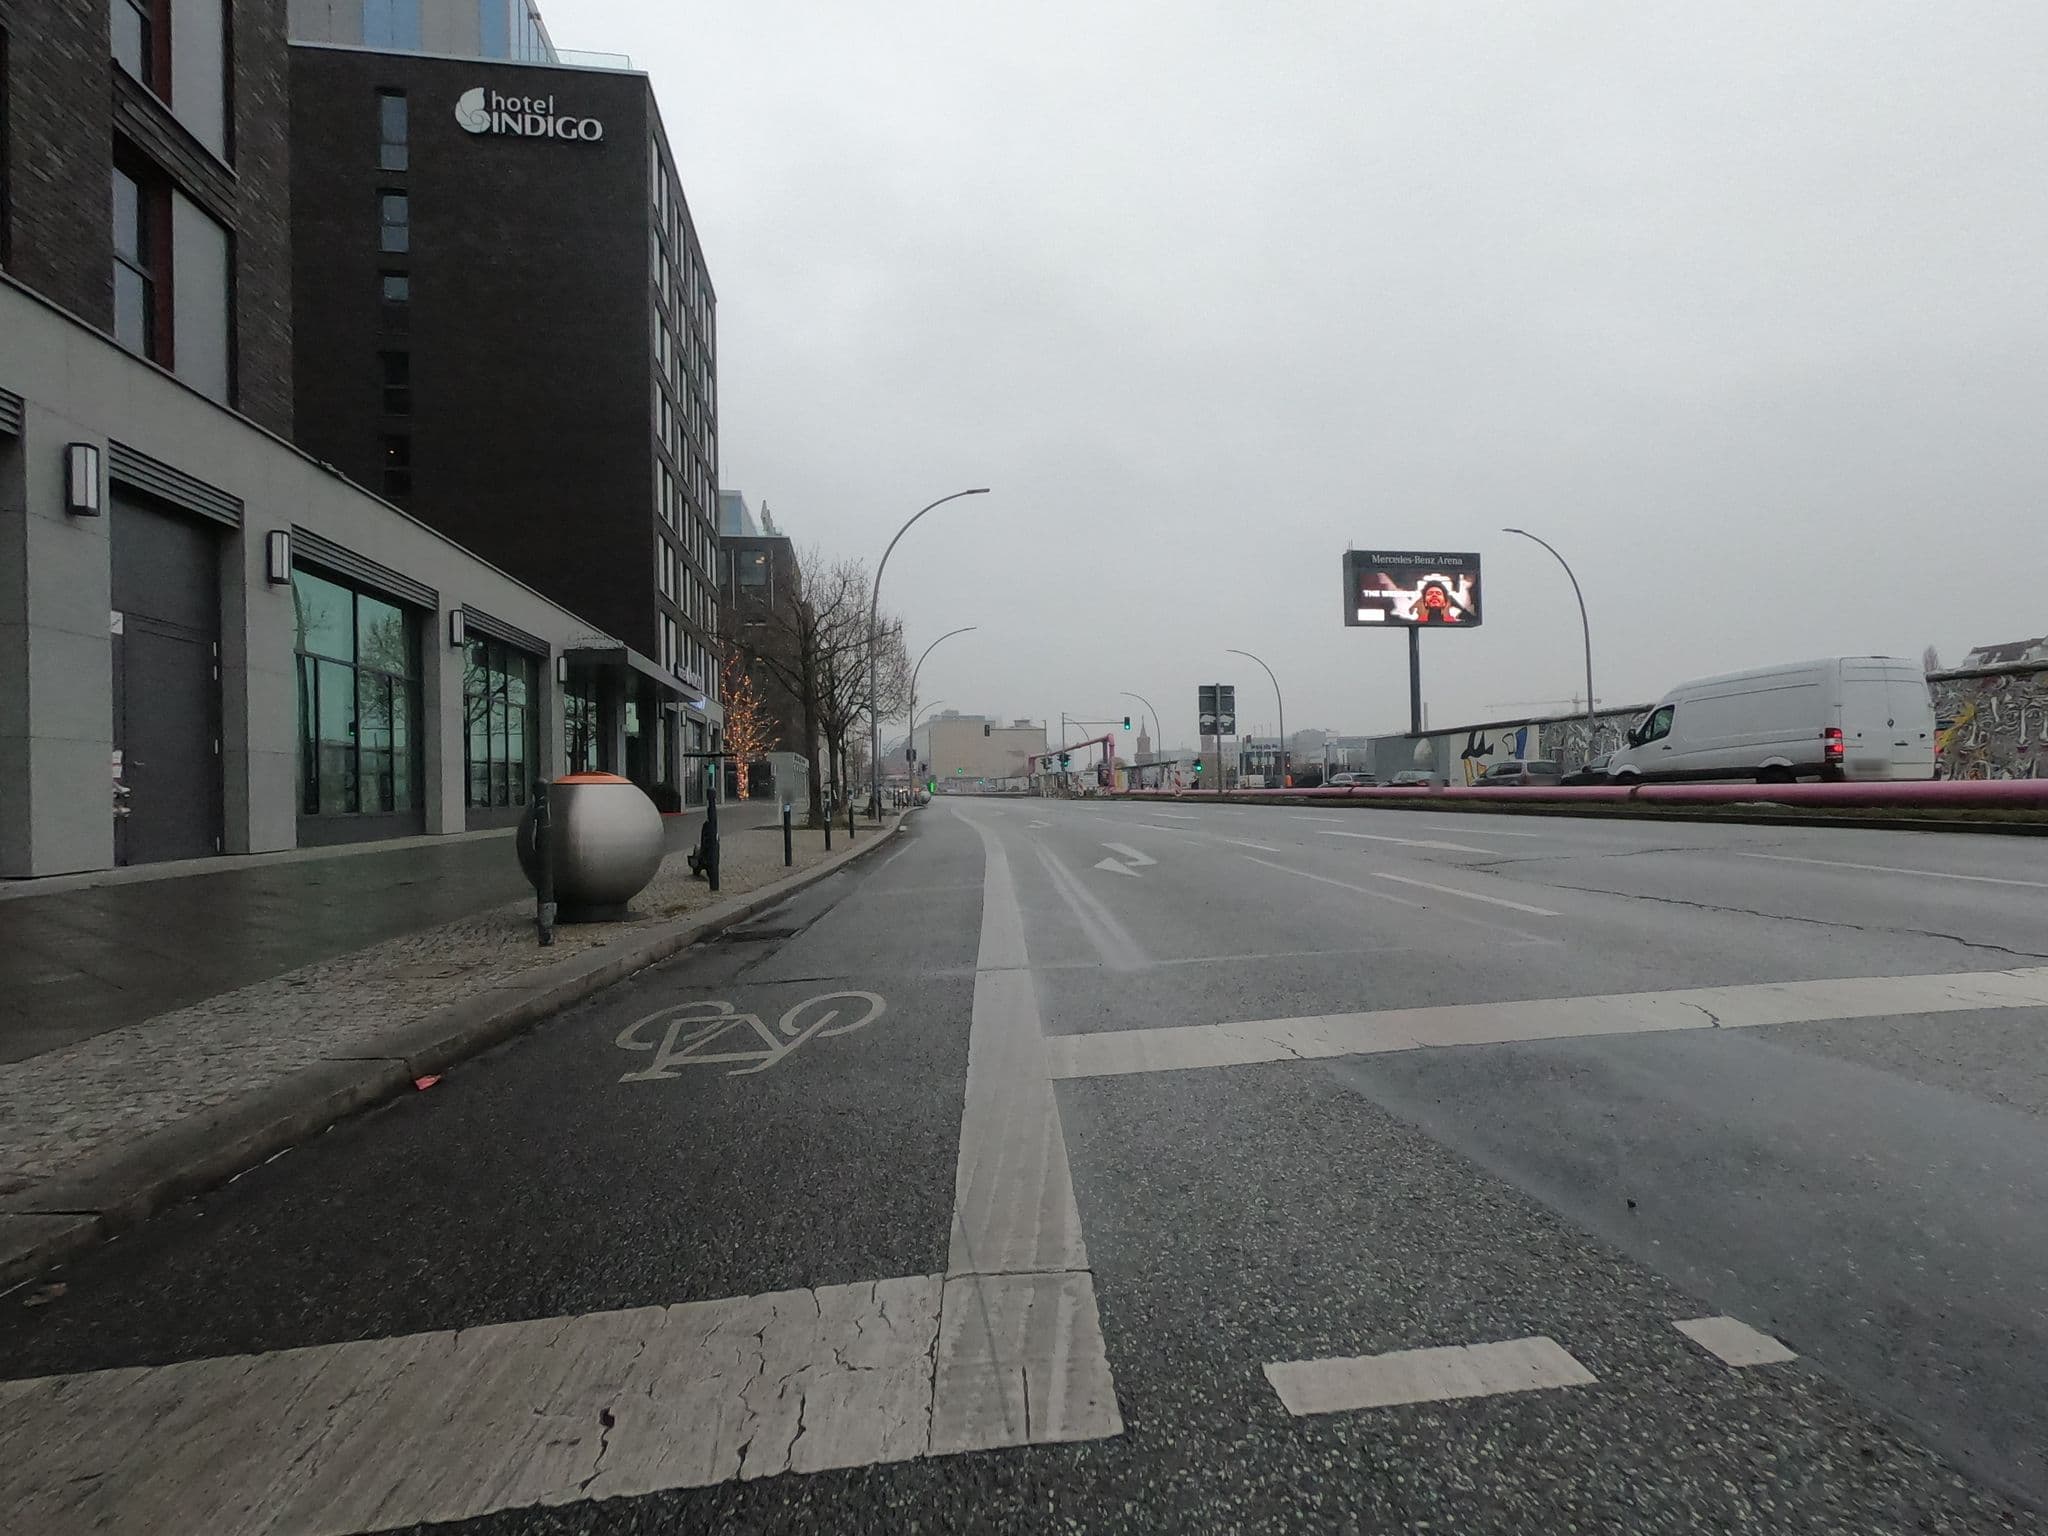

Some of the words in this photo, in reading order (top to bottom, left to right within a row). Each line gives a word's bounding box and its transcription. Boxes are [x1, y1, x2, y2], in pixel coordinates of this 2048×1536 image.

[492, 90, 554, 114] hotel
[492, 111, 603, 141] INDIGO
[1371, 554, 1435, 566] Mercedes-Benz
[1437, 555, 1463, 566] Arena
